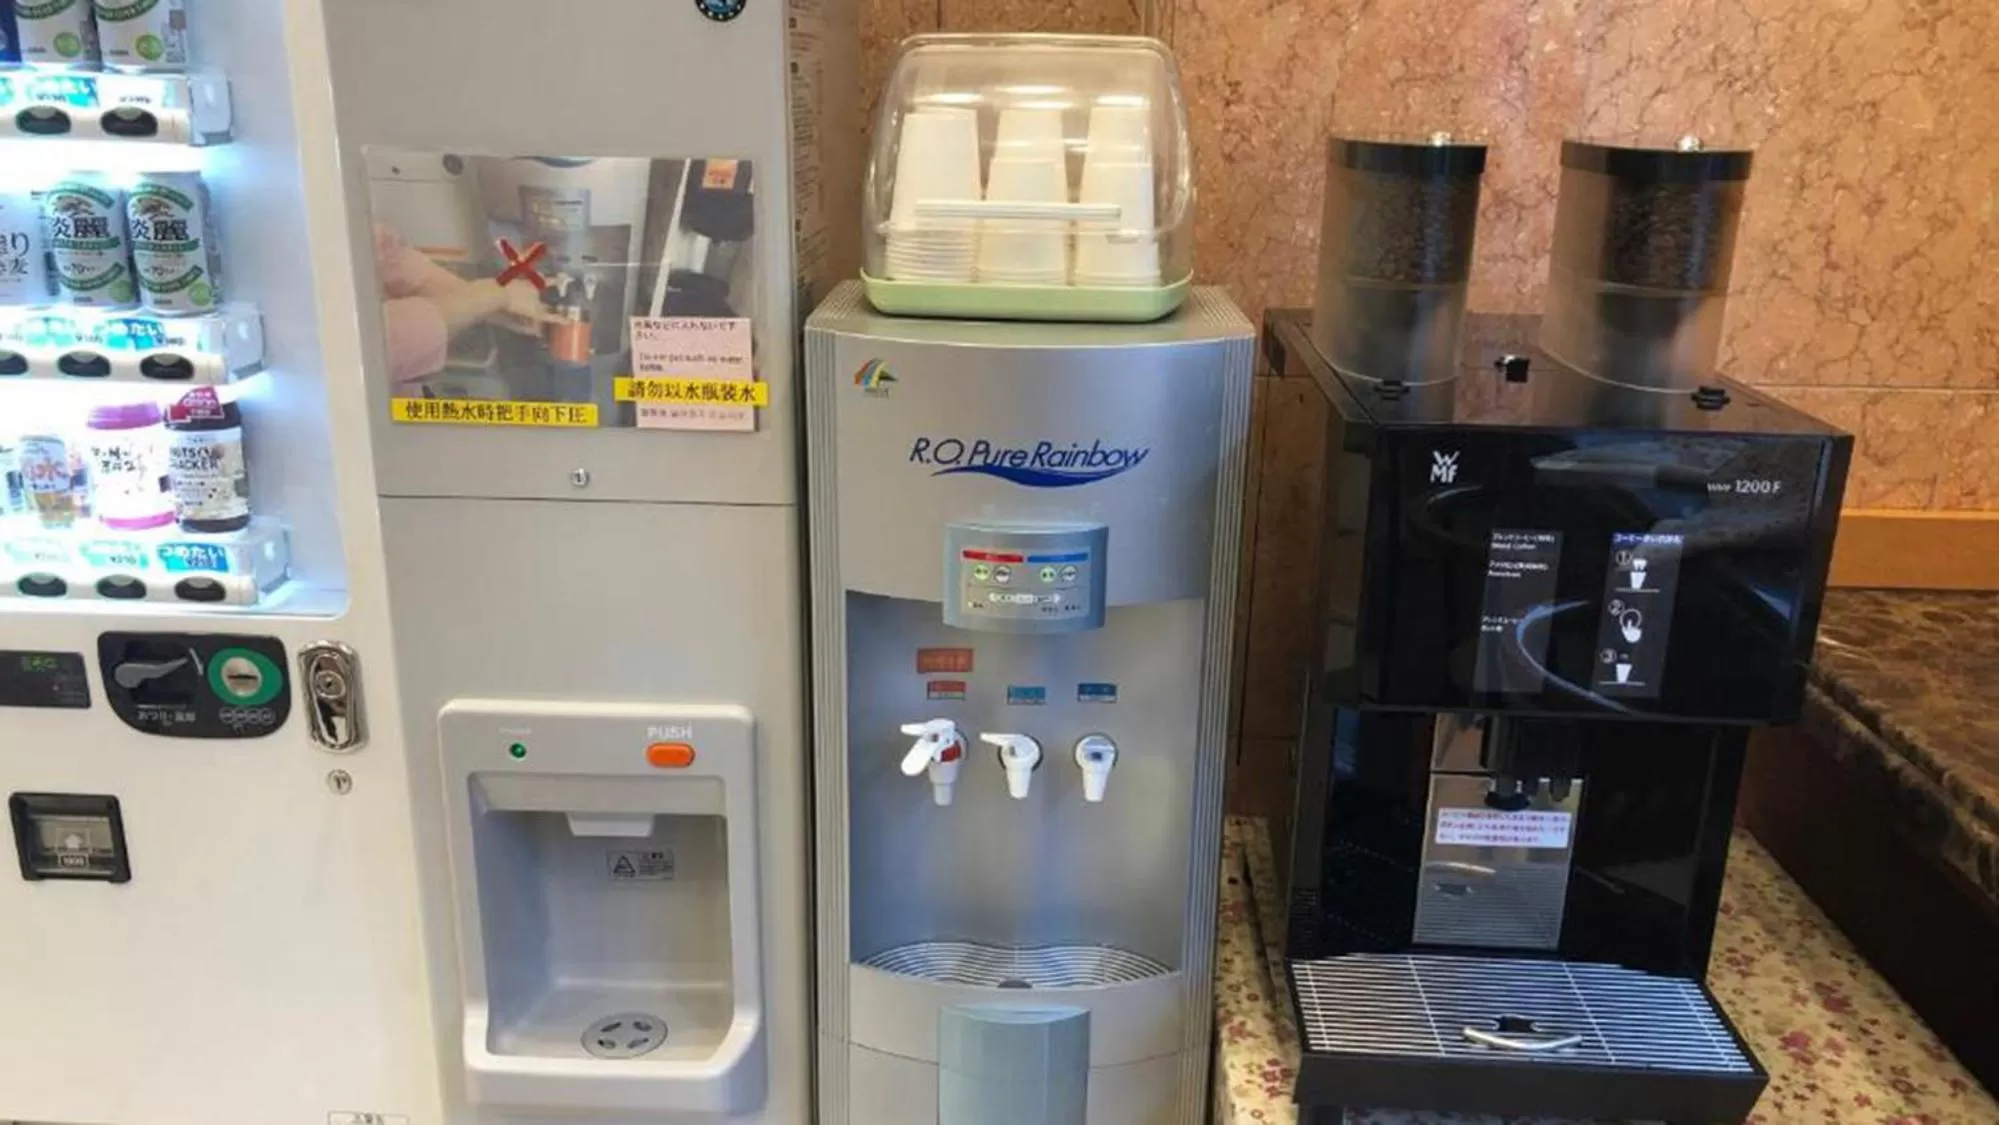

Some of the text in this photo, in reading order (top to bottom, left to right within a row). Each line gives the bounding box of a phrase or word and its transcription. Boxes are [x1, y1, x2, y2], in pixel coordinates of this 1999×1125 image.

[967, 439, 1028, 467] Pure
[1030, 438, 1150, 467] Rainbow
[646, 725, 693, 739] PUSH
